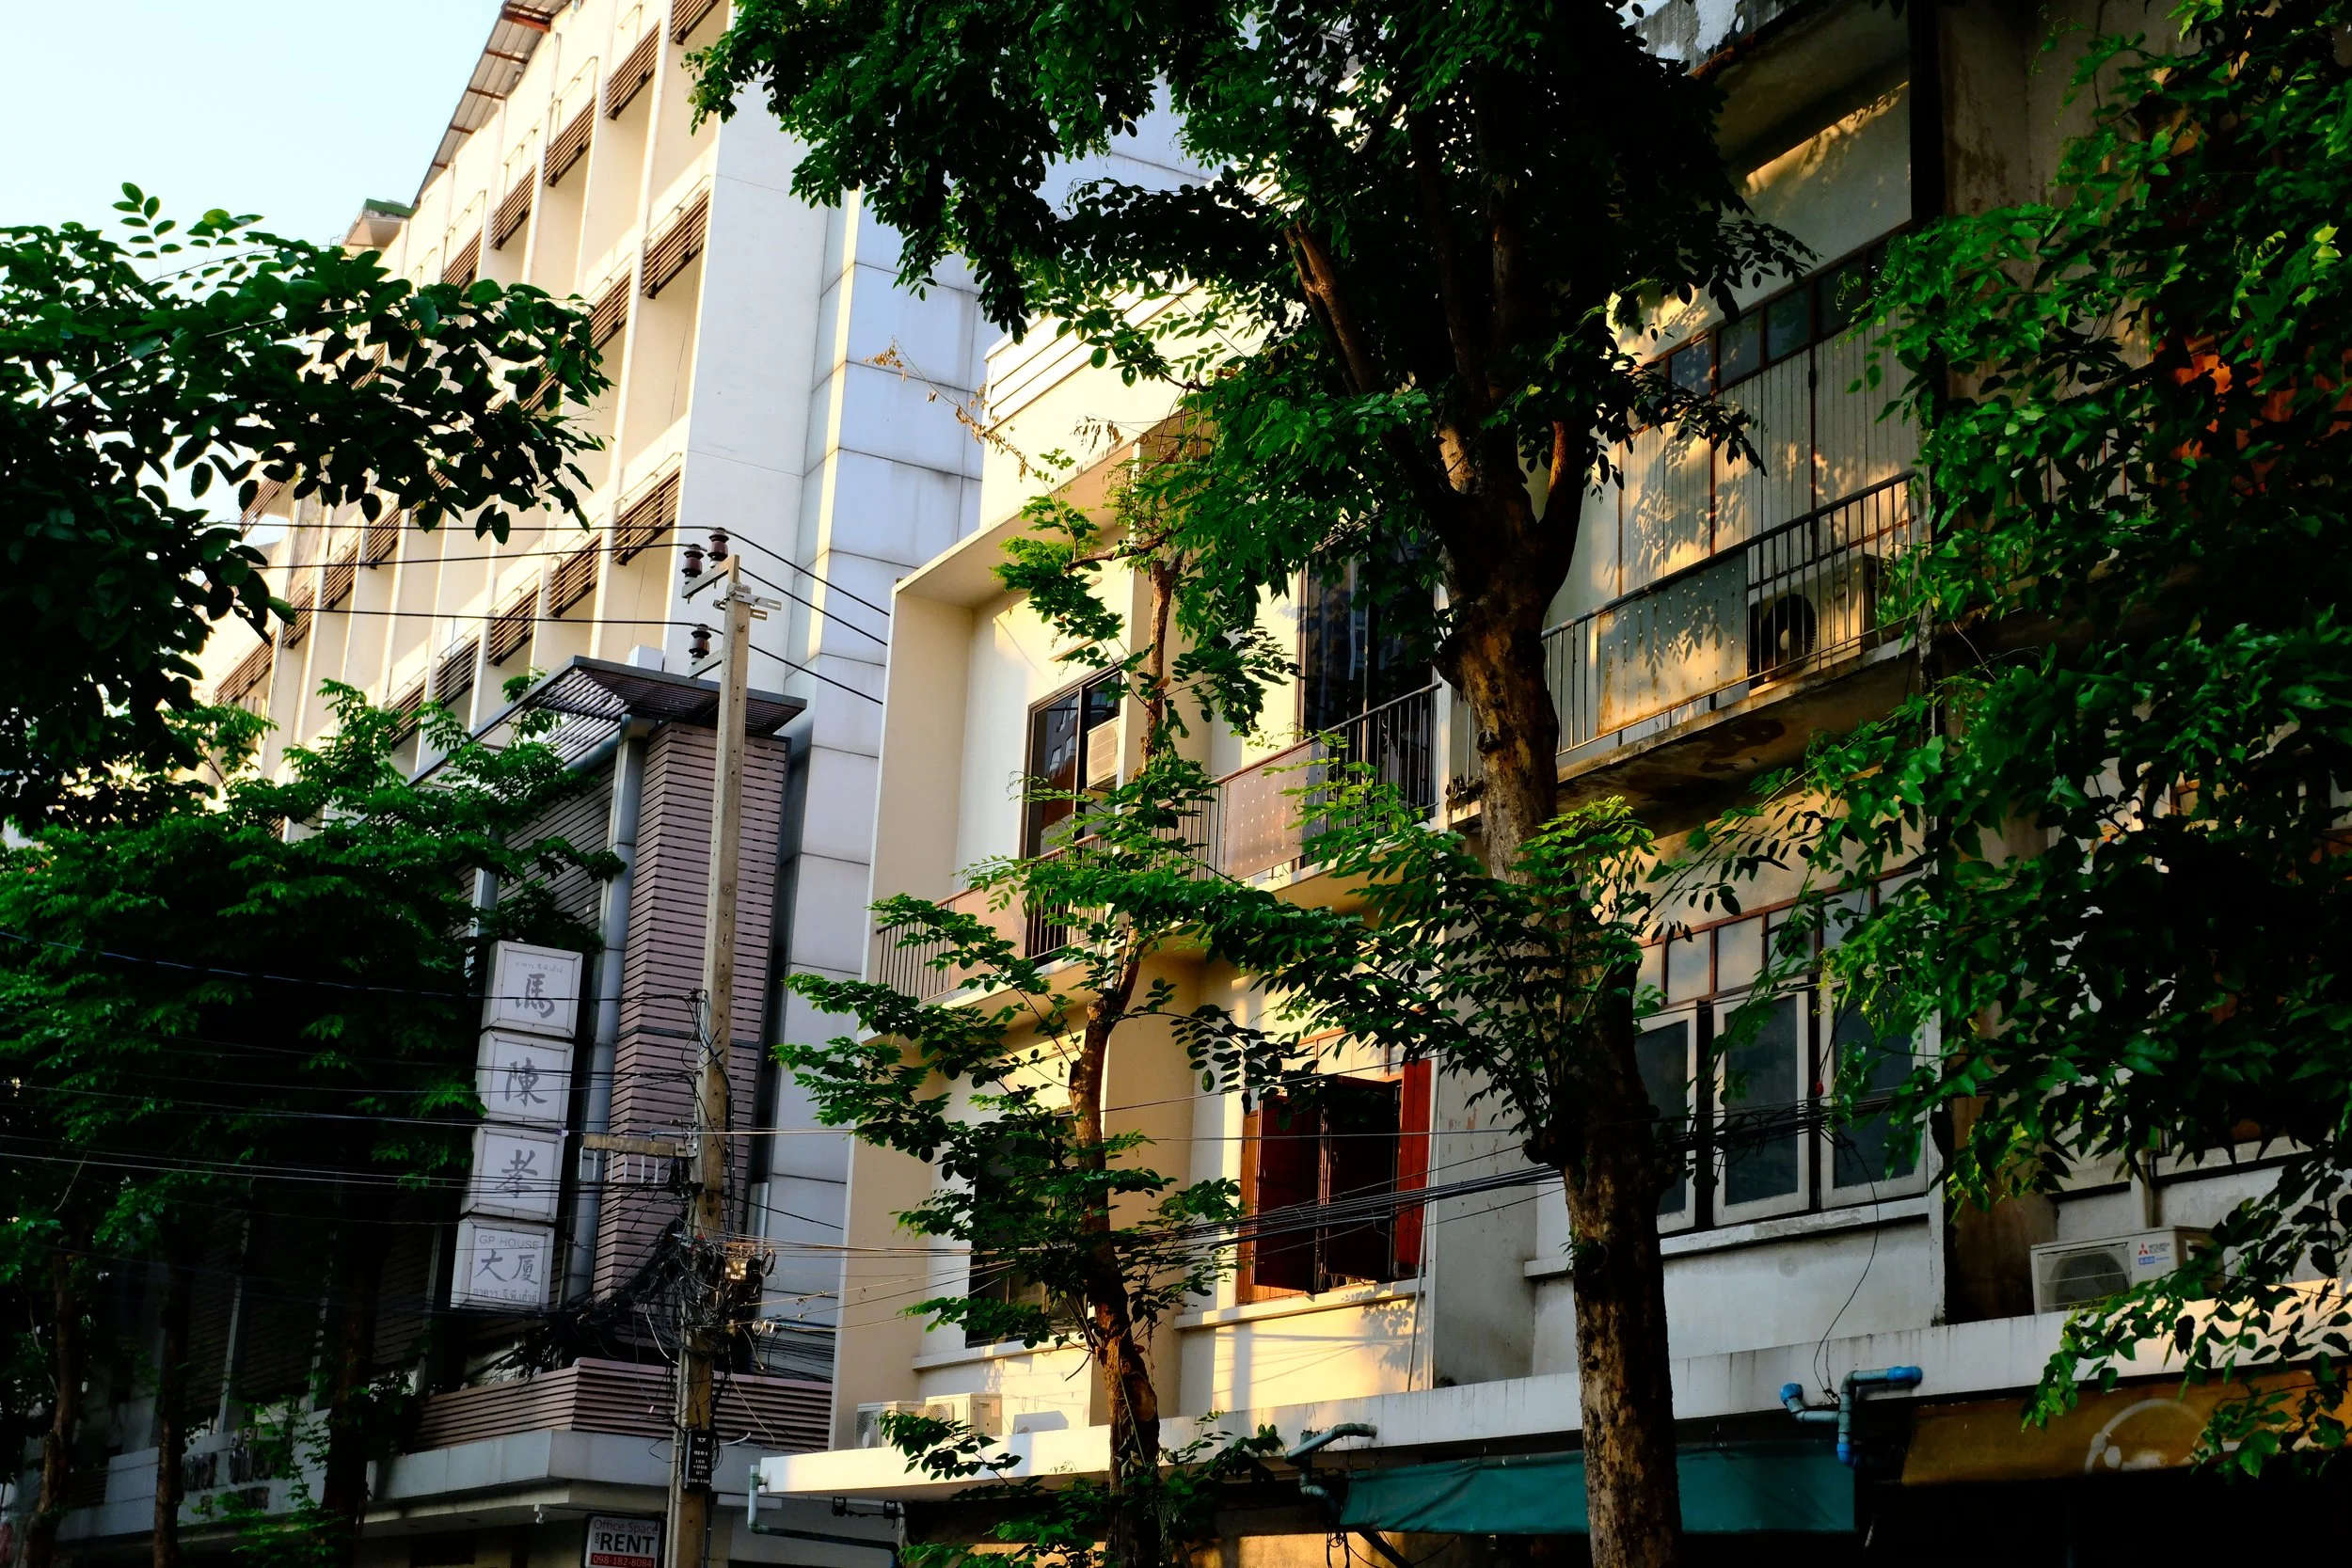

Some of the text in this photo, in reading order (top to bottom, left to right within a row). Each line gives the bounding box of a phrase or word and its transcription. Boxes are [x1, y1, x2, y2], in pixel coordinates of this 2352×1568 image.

[479, 1234, 540, 1250] GP HOUSE
[594, 1519, 659, 1535] Office Space
[599, 1532, 655, 1555] RENT
[592, 1554, 652, 1568] 098-182-8084
